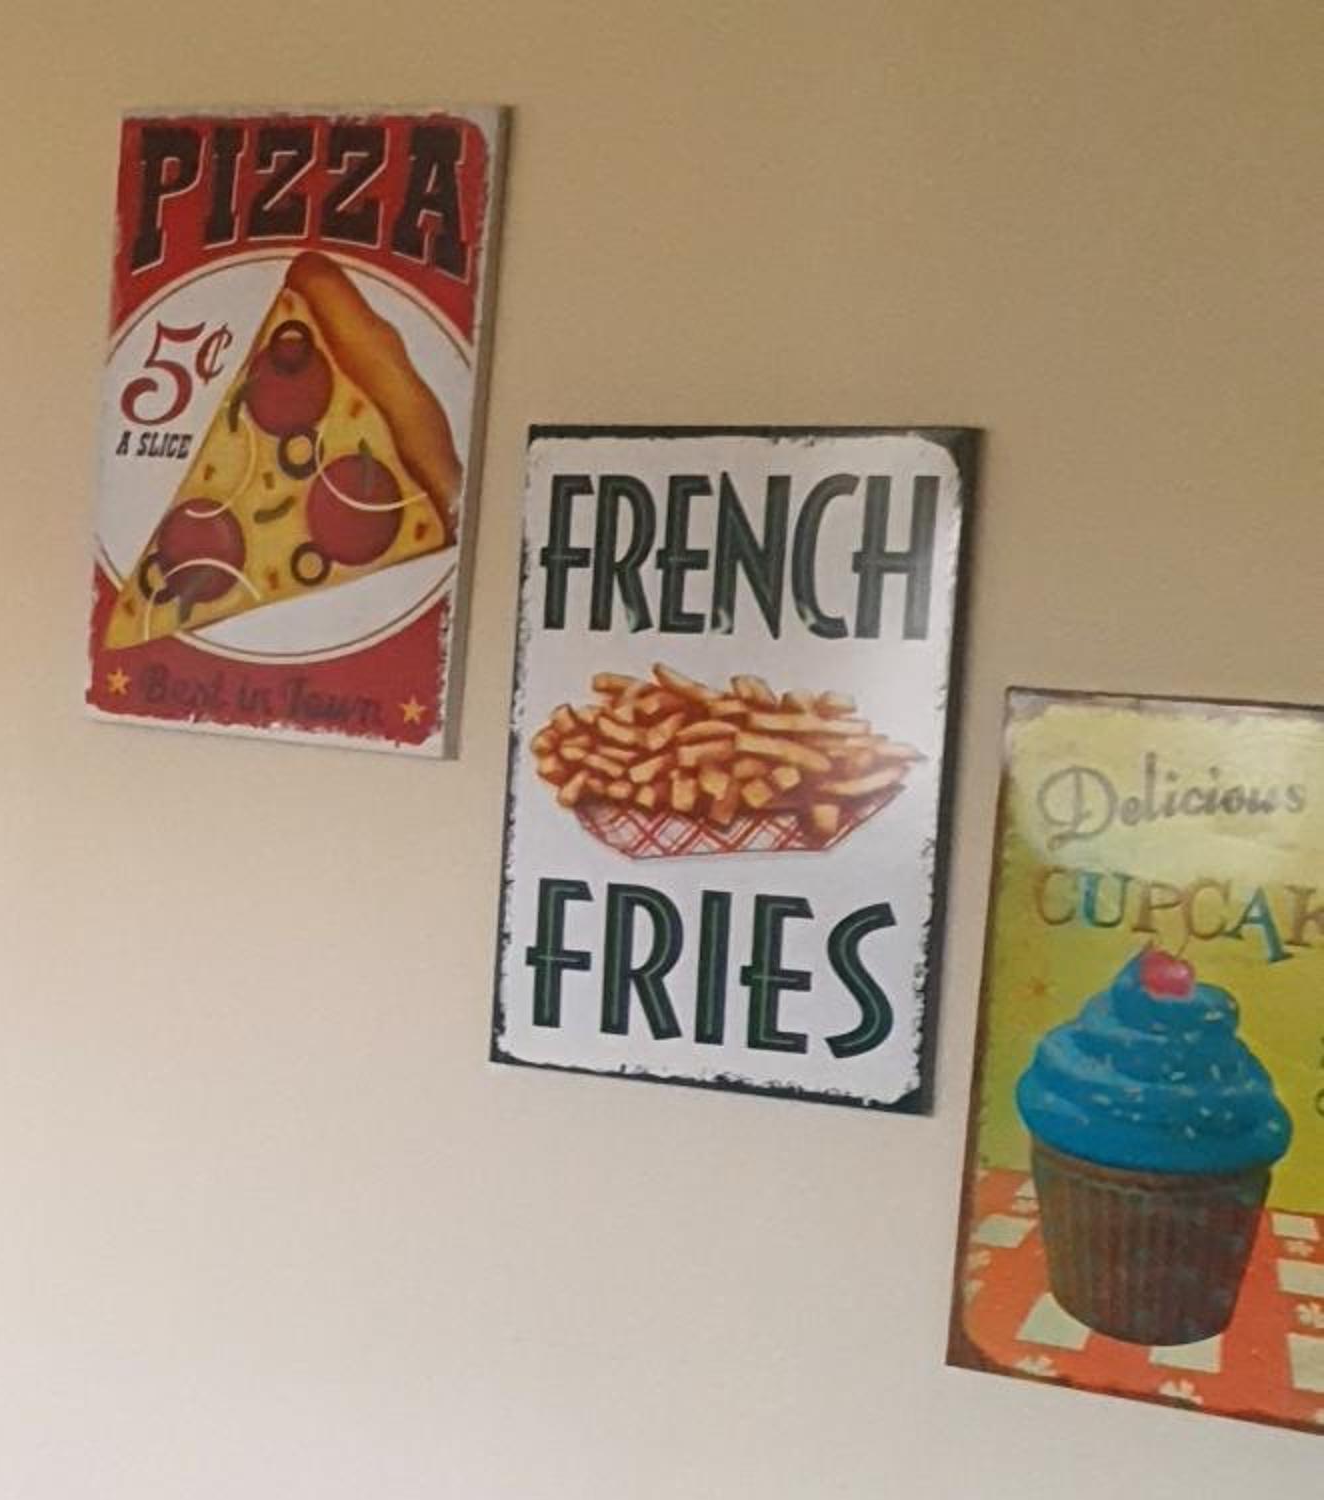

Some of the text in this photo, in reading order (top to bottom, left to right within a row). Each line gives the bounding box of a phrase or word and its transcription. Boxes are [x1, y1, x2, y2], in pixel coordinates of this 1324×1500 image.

[131, 126, 472, 286] PIZZA
[115, 430, 195, 460] A SLICE
[539, 471, 941, 641] FRENCH
[1036, 751, 1308, 851] Delicious
[525, 877, 898, 1060] FRIES
